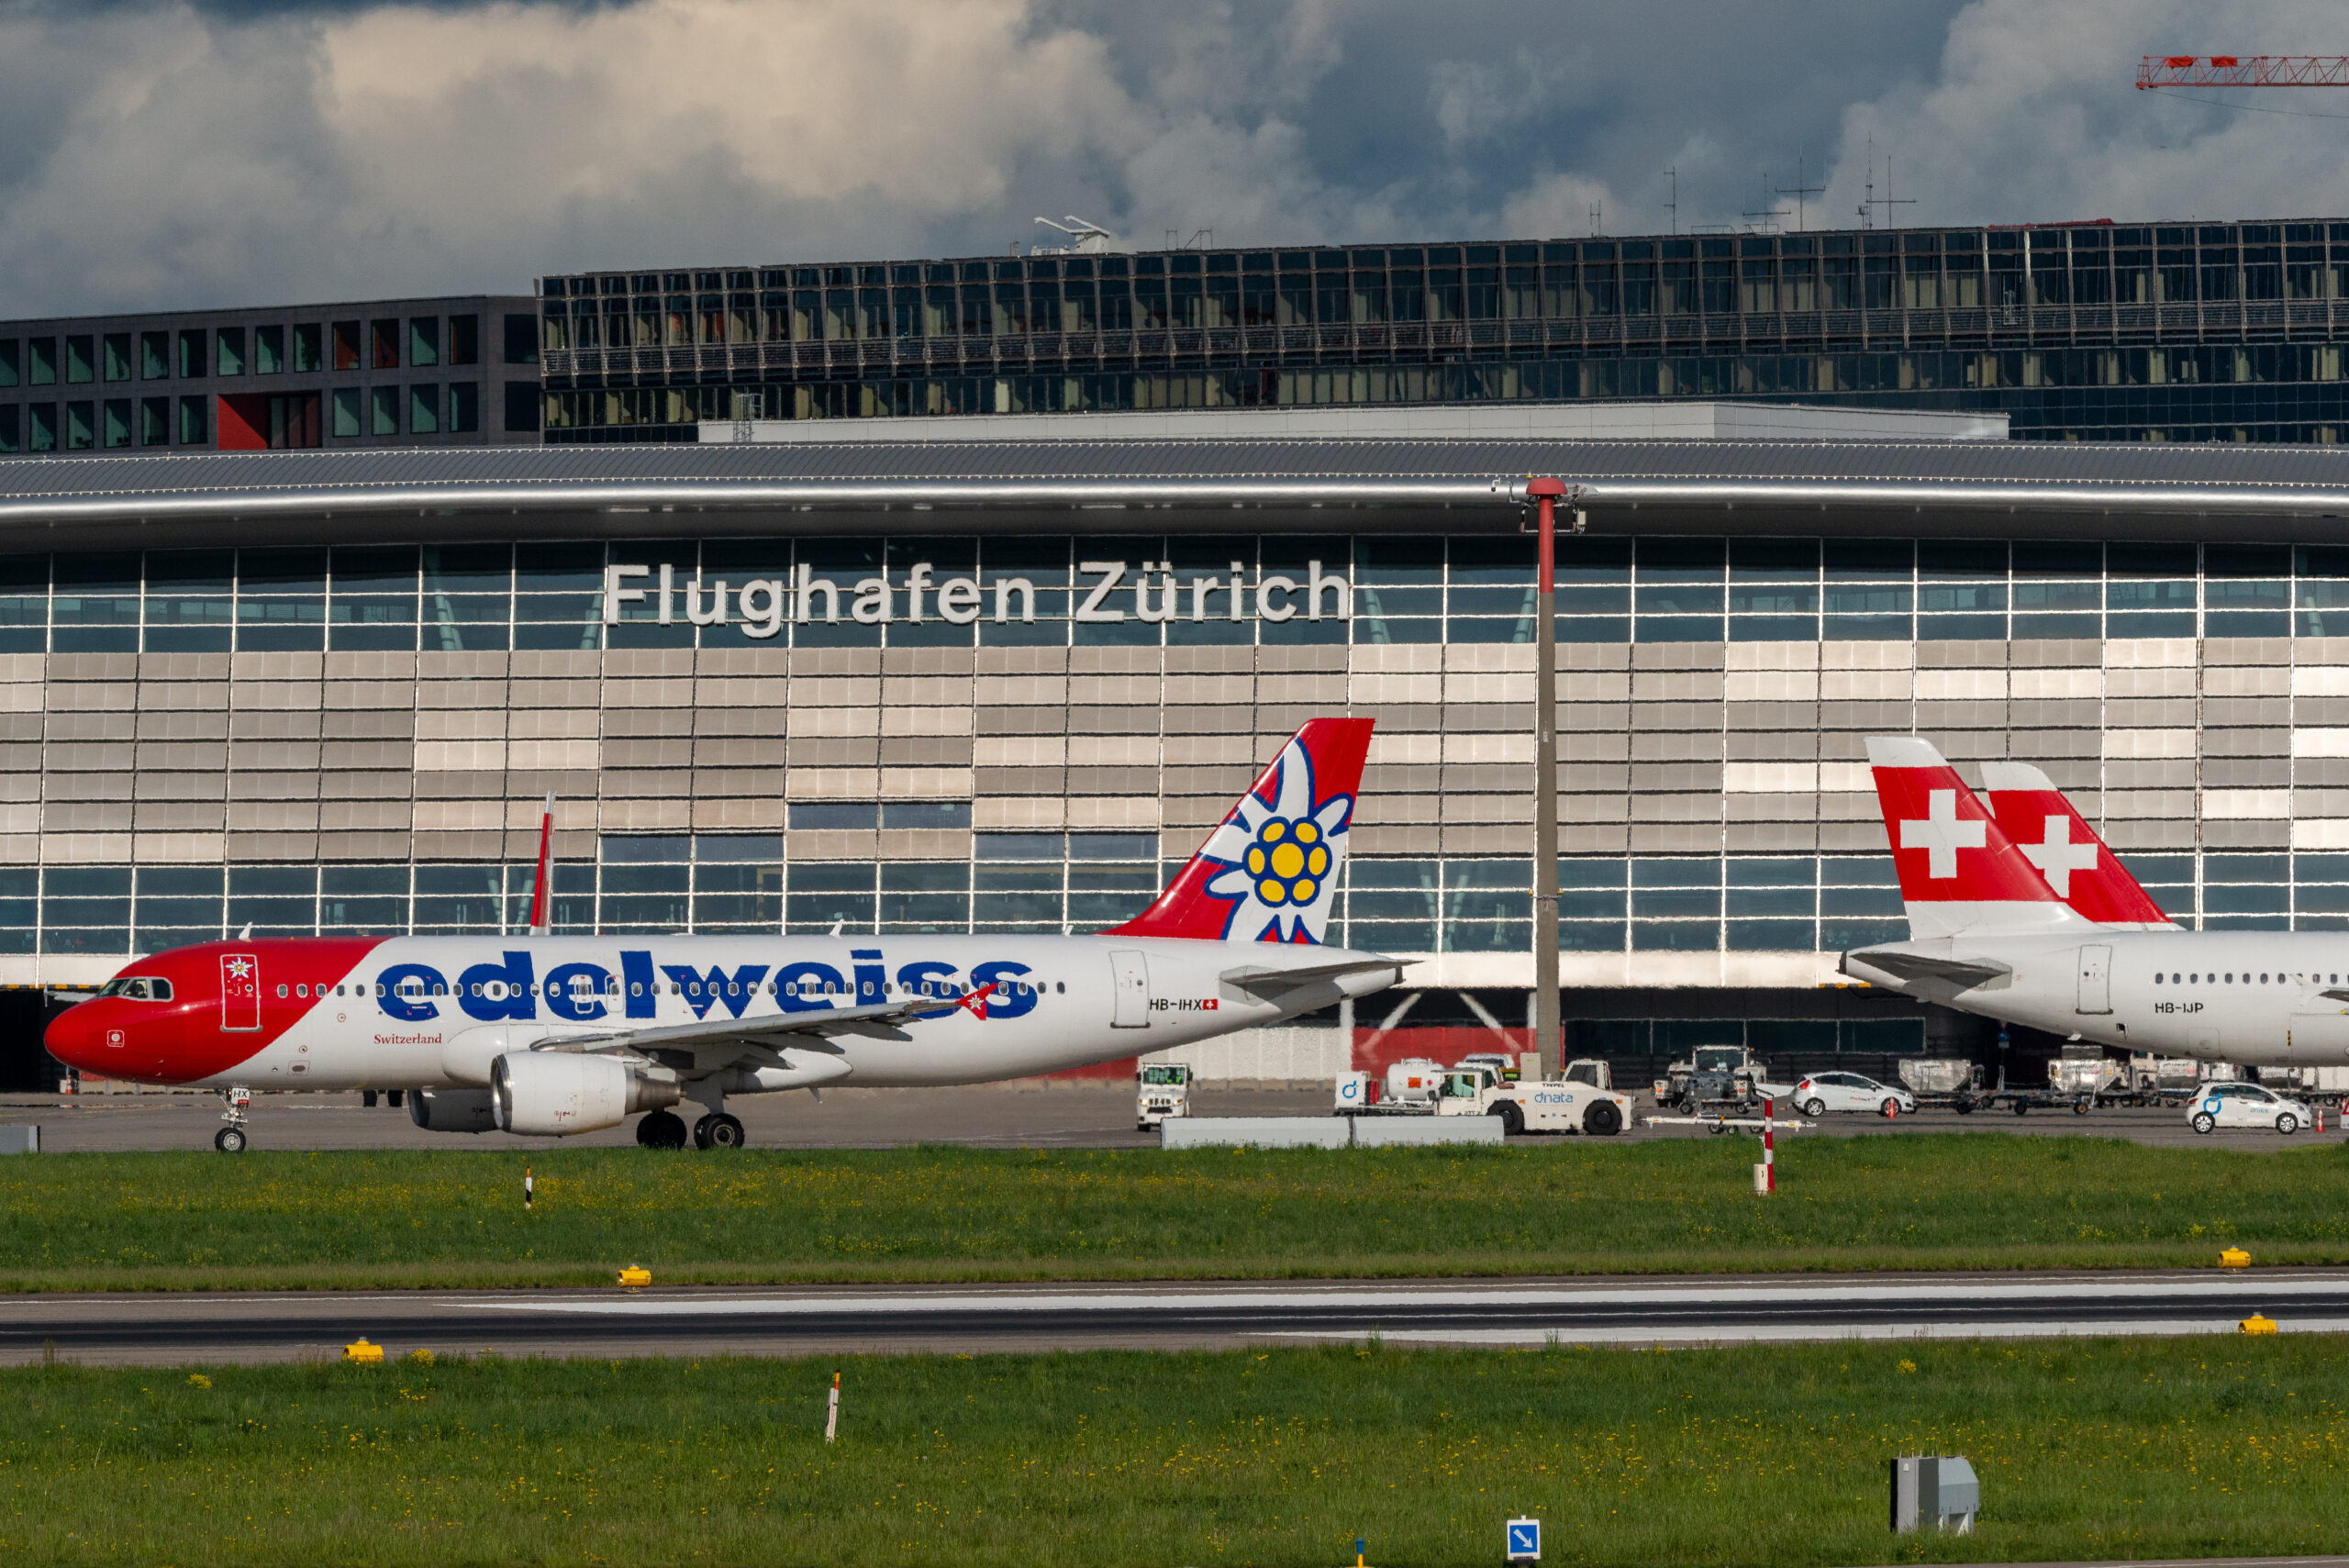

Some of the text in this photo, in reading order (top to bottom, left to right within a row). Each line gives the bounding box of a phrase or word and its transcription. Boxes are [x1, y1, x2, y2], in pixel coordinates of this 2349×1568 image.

[607, 561, 1350, 639] Flughafen Zürich
[375, 949, 1038, 1022] edelweiss
[1149, 998, 1202, 1011] HB-IHX
[2154, 1002, 2204, 1014] HB-IJP
[373, 1032, 442, 1044] Switzerland
[233, 1090, 248, 1098] HX
[1534, 1091, 1574, 1104] dnata
